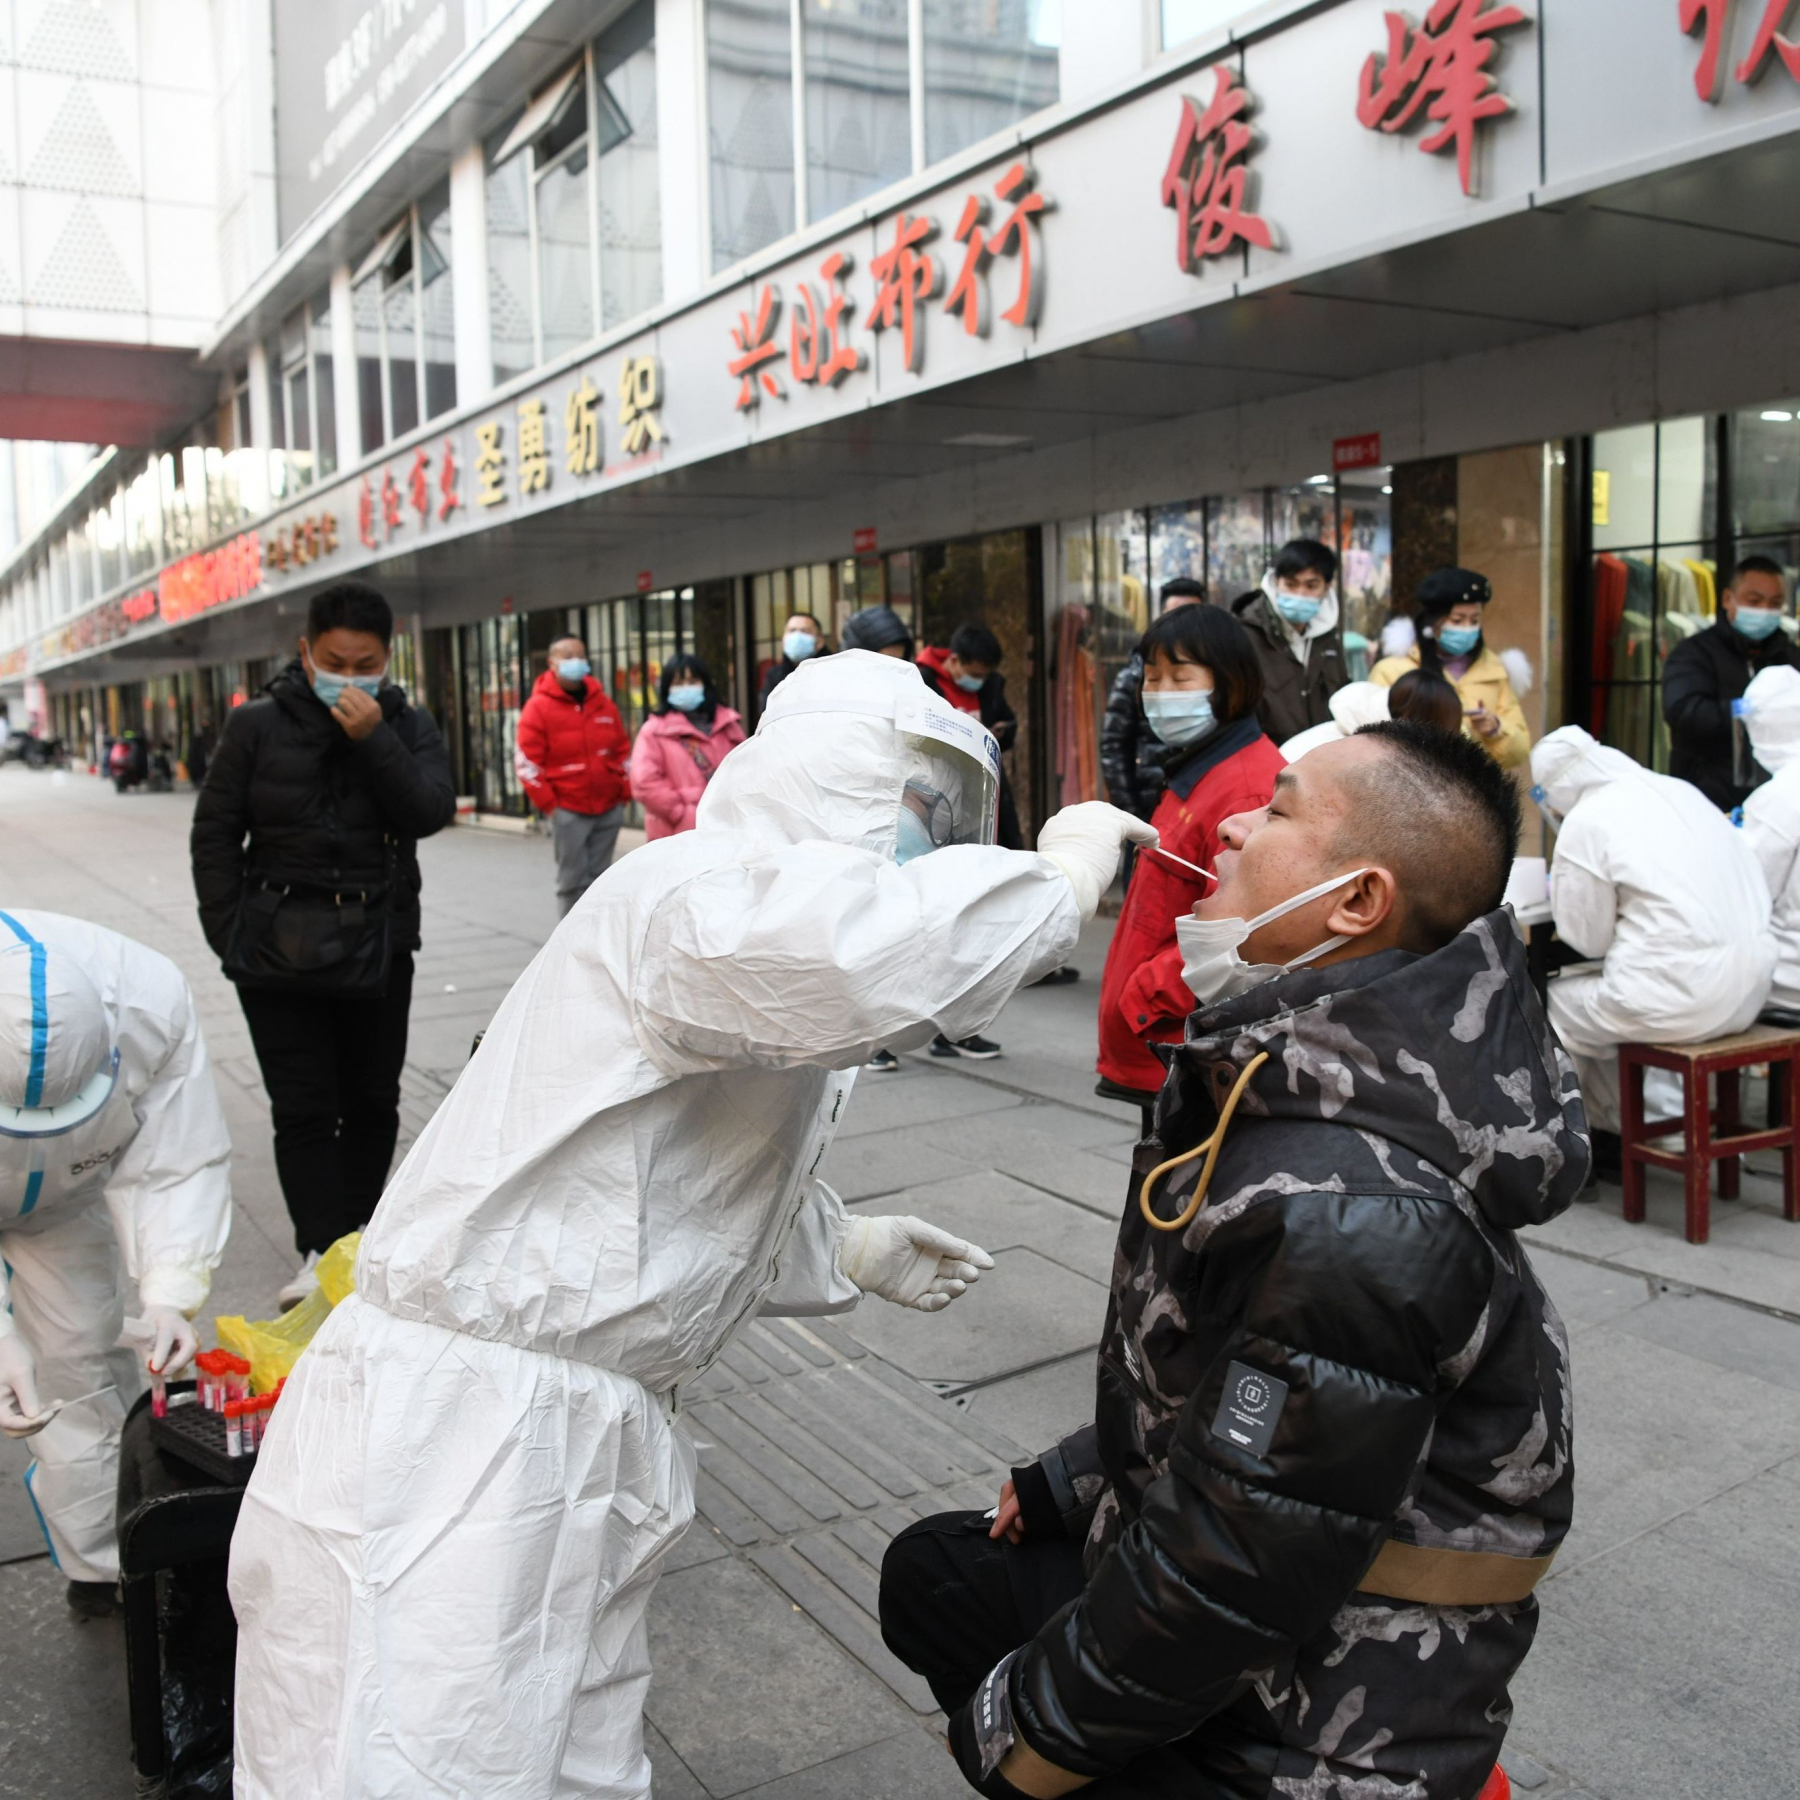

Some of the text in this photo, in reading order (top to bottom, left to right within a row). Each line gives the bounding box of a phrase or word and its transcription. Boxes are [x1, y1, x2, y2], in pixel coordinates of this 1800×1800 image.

[727, 163, 1052, 411] 兴旺布行
[475, 355, 664, 507] 圣勇纺织
